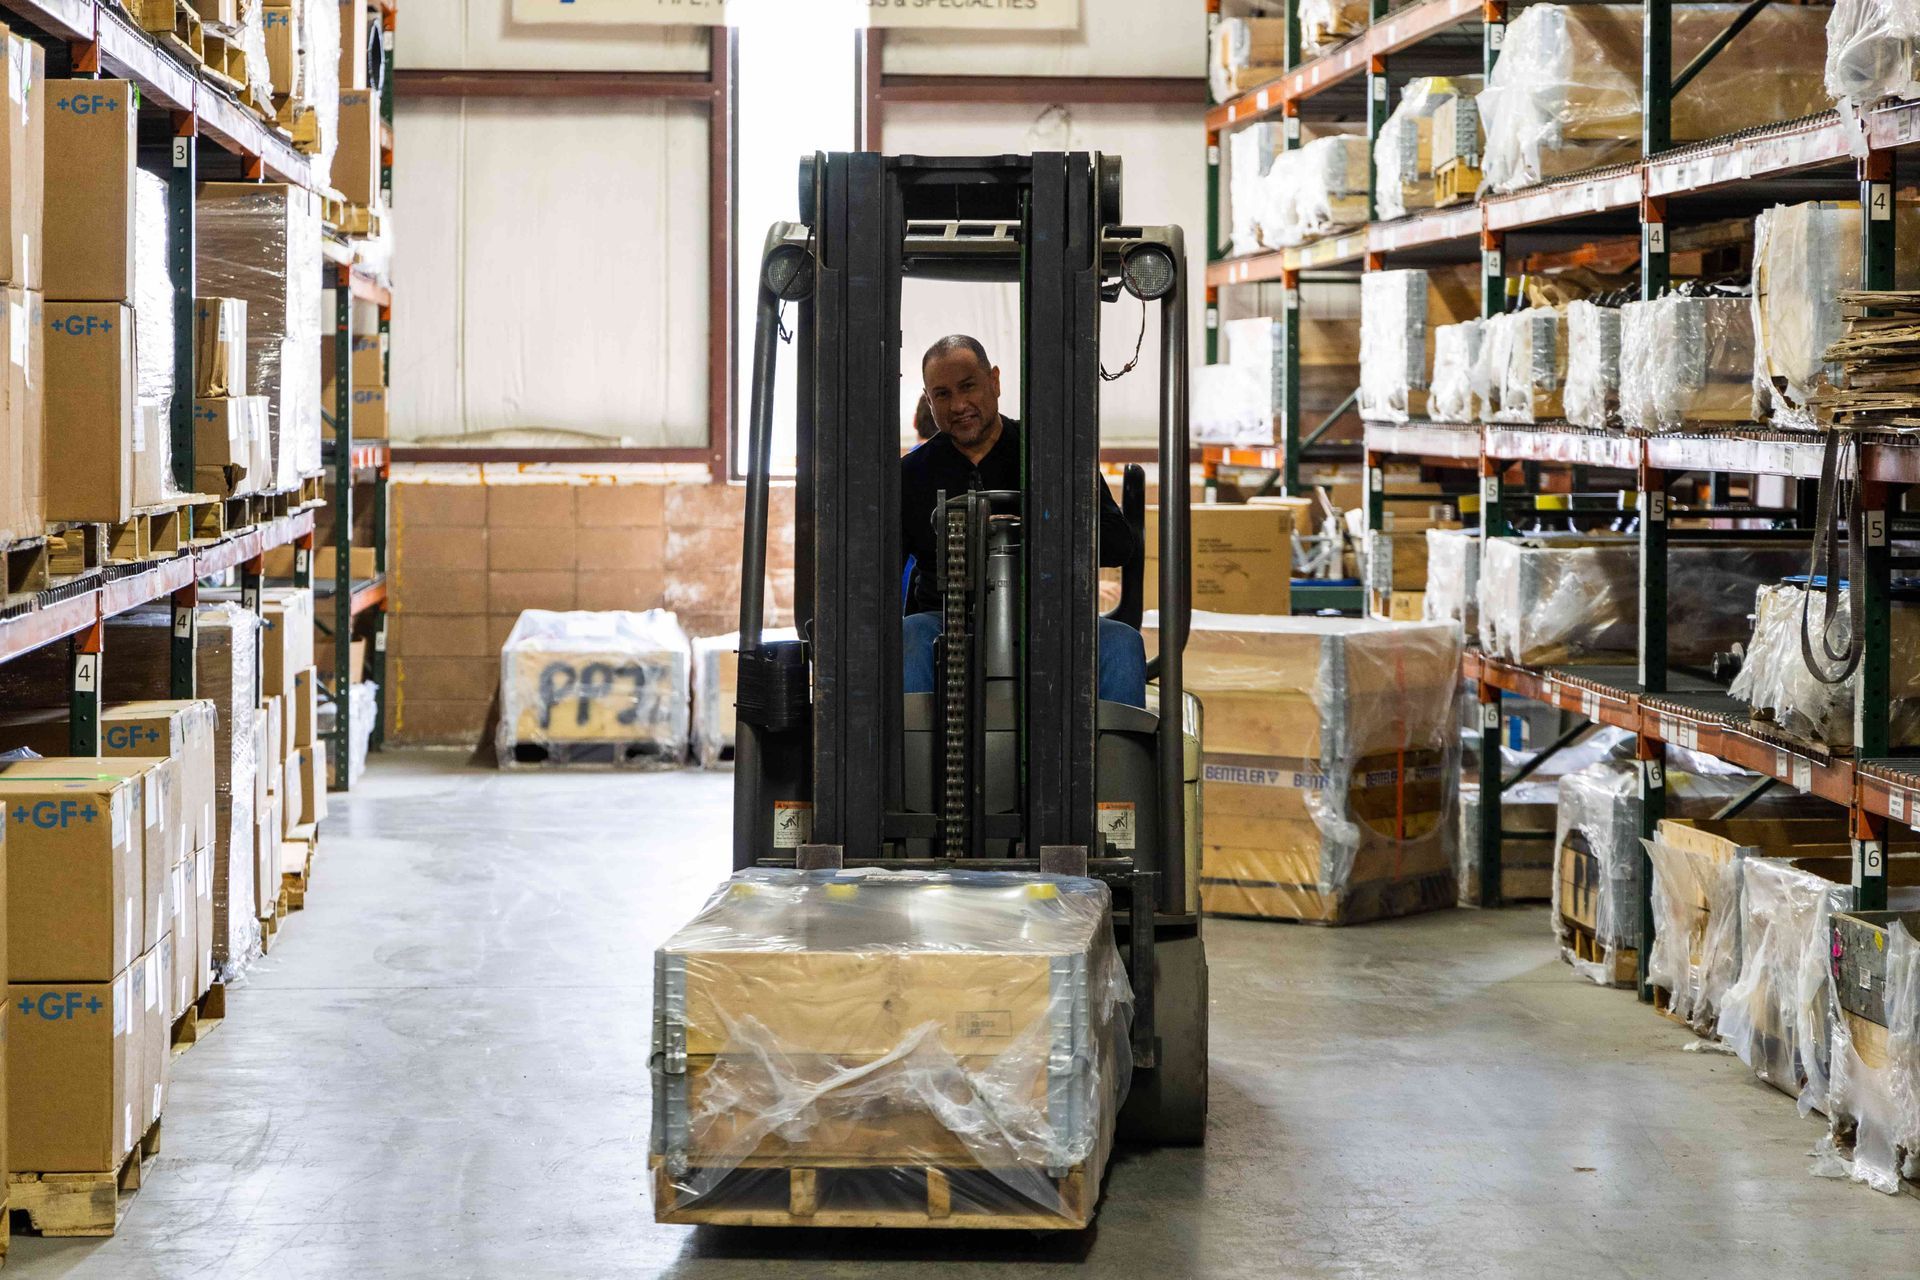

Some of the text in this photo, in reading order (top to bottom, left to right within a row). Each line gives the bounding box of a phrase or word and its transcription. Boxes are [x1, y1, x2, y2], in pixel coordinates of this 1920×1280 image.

[175, 145, 185, 160] 3
[1874, 192, 1886, 210] 4
[1651, 230, 1661, 244] 4
[1490, 256, 1498, 269] 4
[1487, 483, 1496, 495] 5
[1654, 500, 1664, 514] 5
[1872, 520, 1883, 538] 5
[244, 596, 253, 609] 4
[176, 615, 188, 629] 4
[78, 664, 91, 682] 4
[1488, 708, 1496, 721] 6
[1205, 765, 1266, 784] BENTELER
[1651, 766, 1661, 781] 6
[1868, 850, 1880, 868] 6
